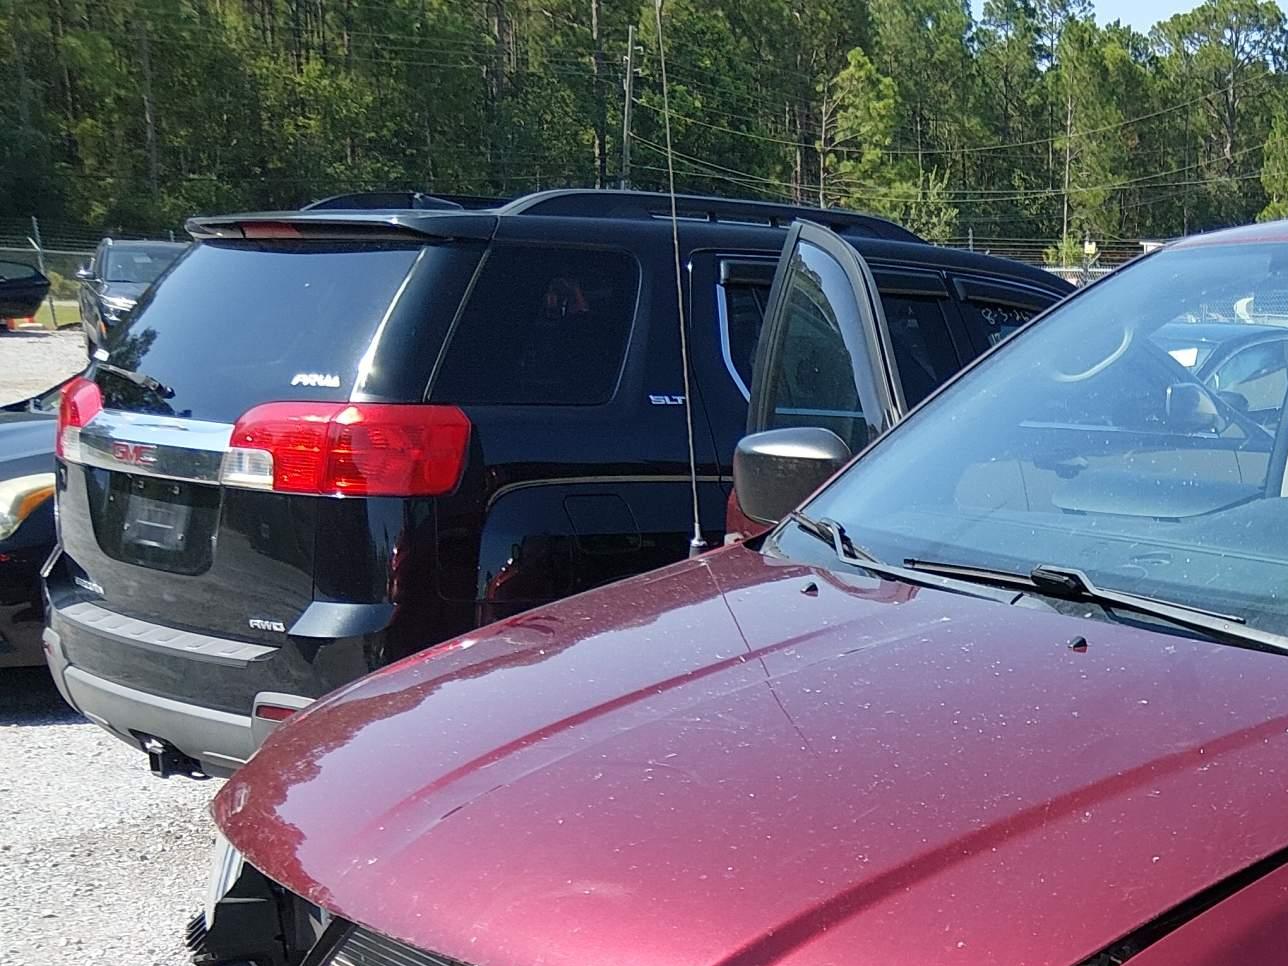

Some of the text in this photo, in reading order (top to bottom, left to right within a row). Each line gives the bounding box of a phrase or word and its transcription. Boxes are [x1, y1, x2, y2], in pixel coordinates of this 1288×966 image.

[648, 394, 686, 405] SLT
[112, 440, 159, 467] GMC
[248, 619, 286, 633] AWD
